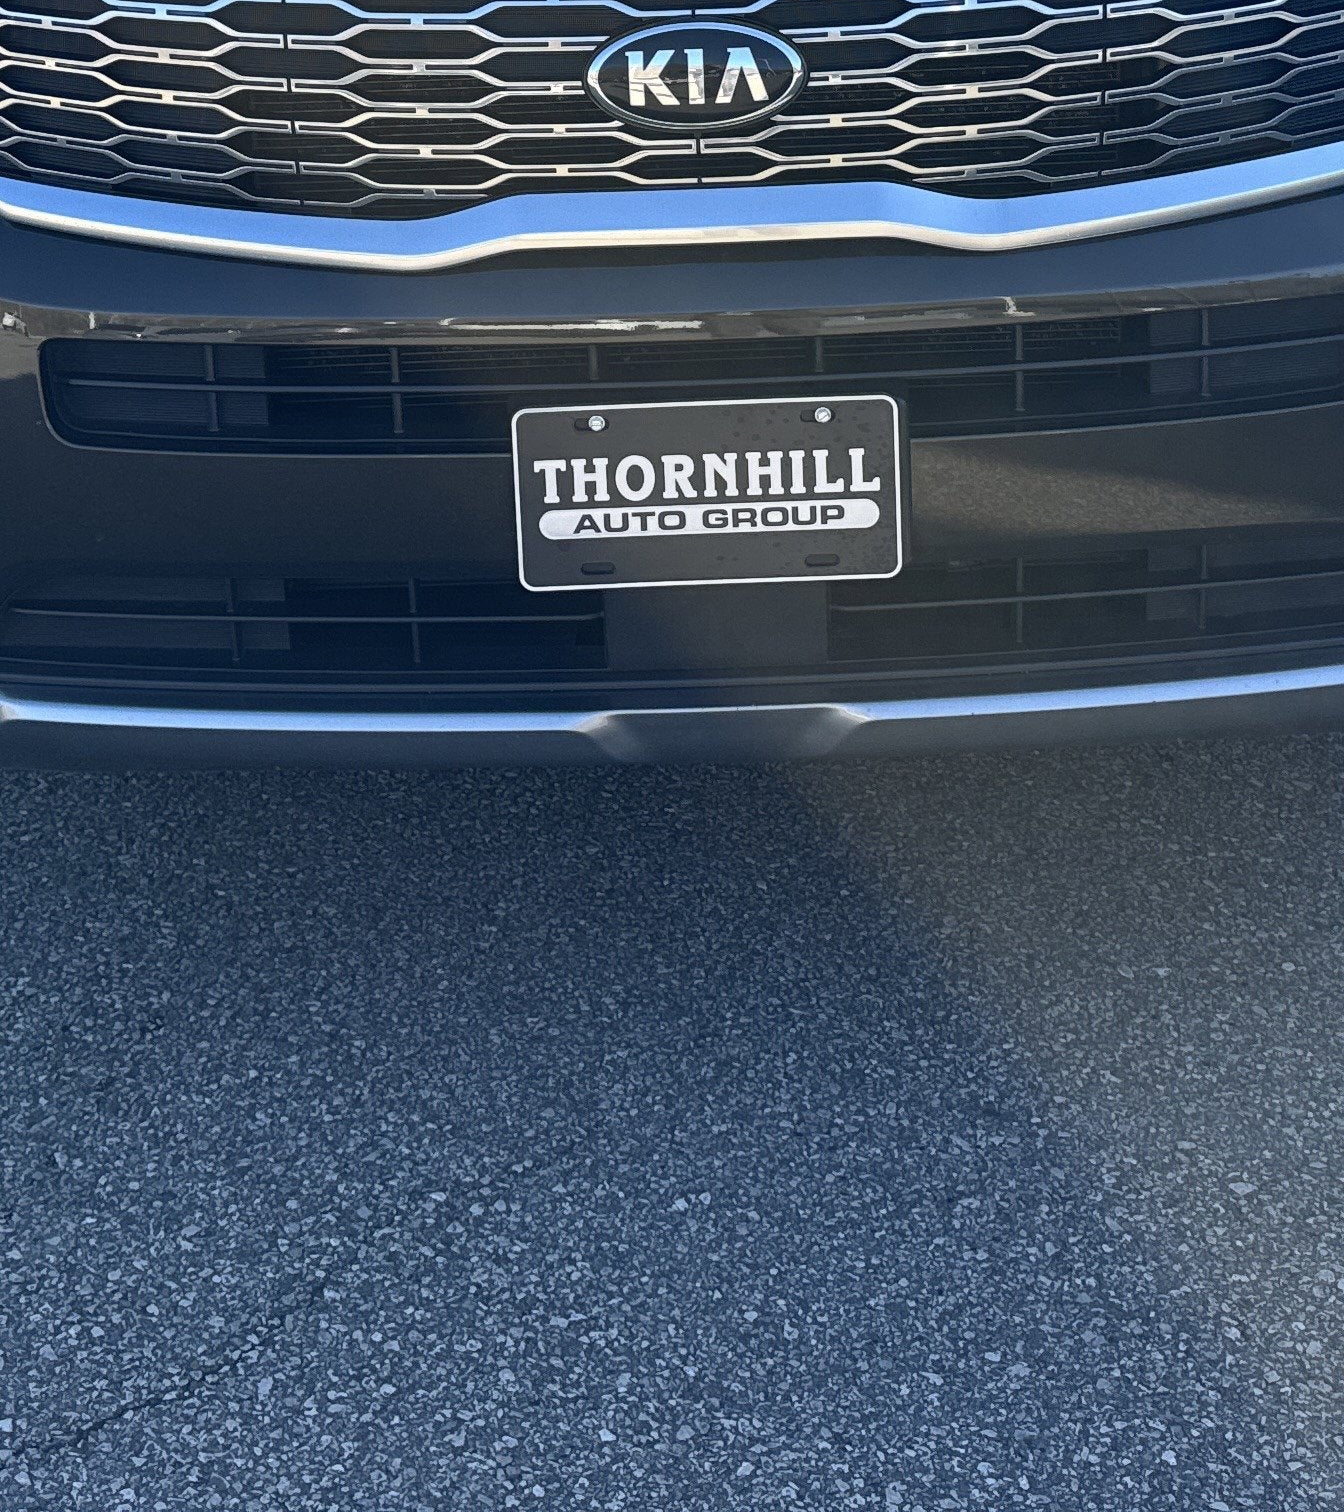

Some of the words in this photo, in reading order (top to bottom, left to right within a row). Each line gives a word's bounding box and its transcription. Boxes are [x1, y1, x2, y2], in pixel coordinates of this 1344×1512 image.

[624, 46, 770, 107] KIA
[533, 448, 881, 504] THORNHILL
[572, 510, 687, 534] AUTO
[701, 504, 845, 529] GROUP
